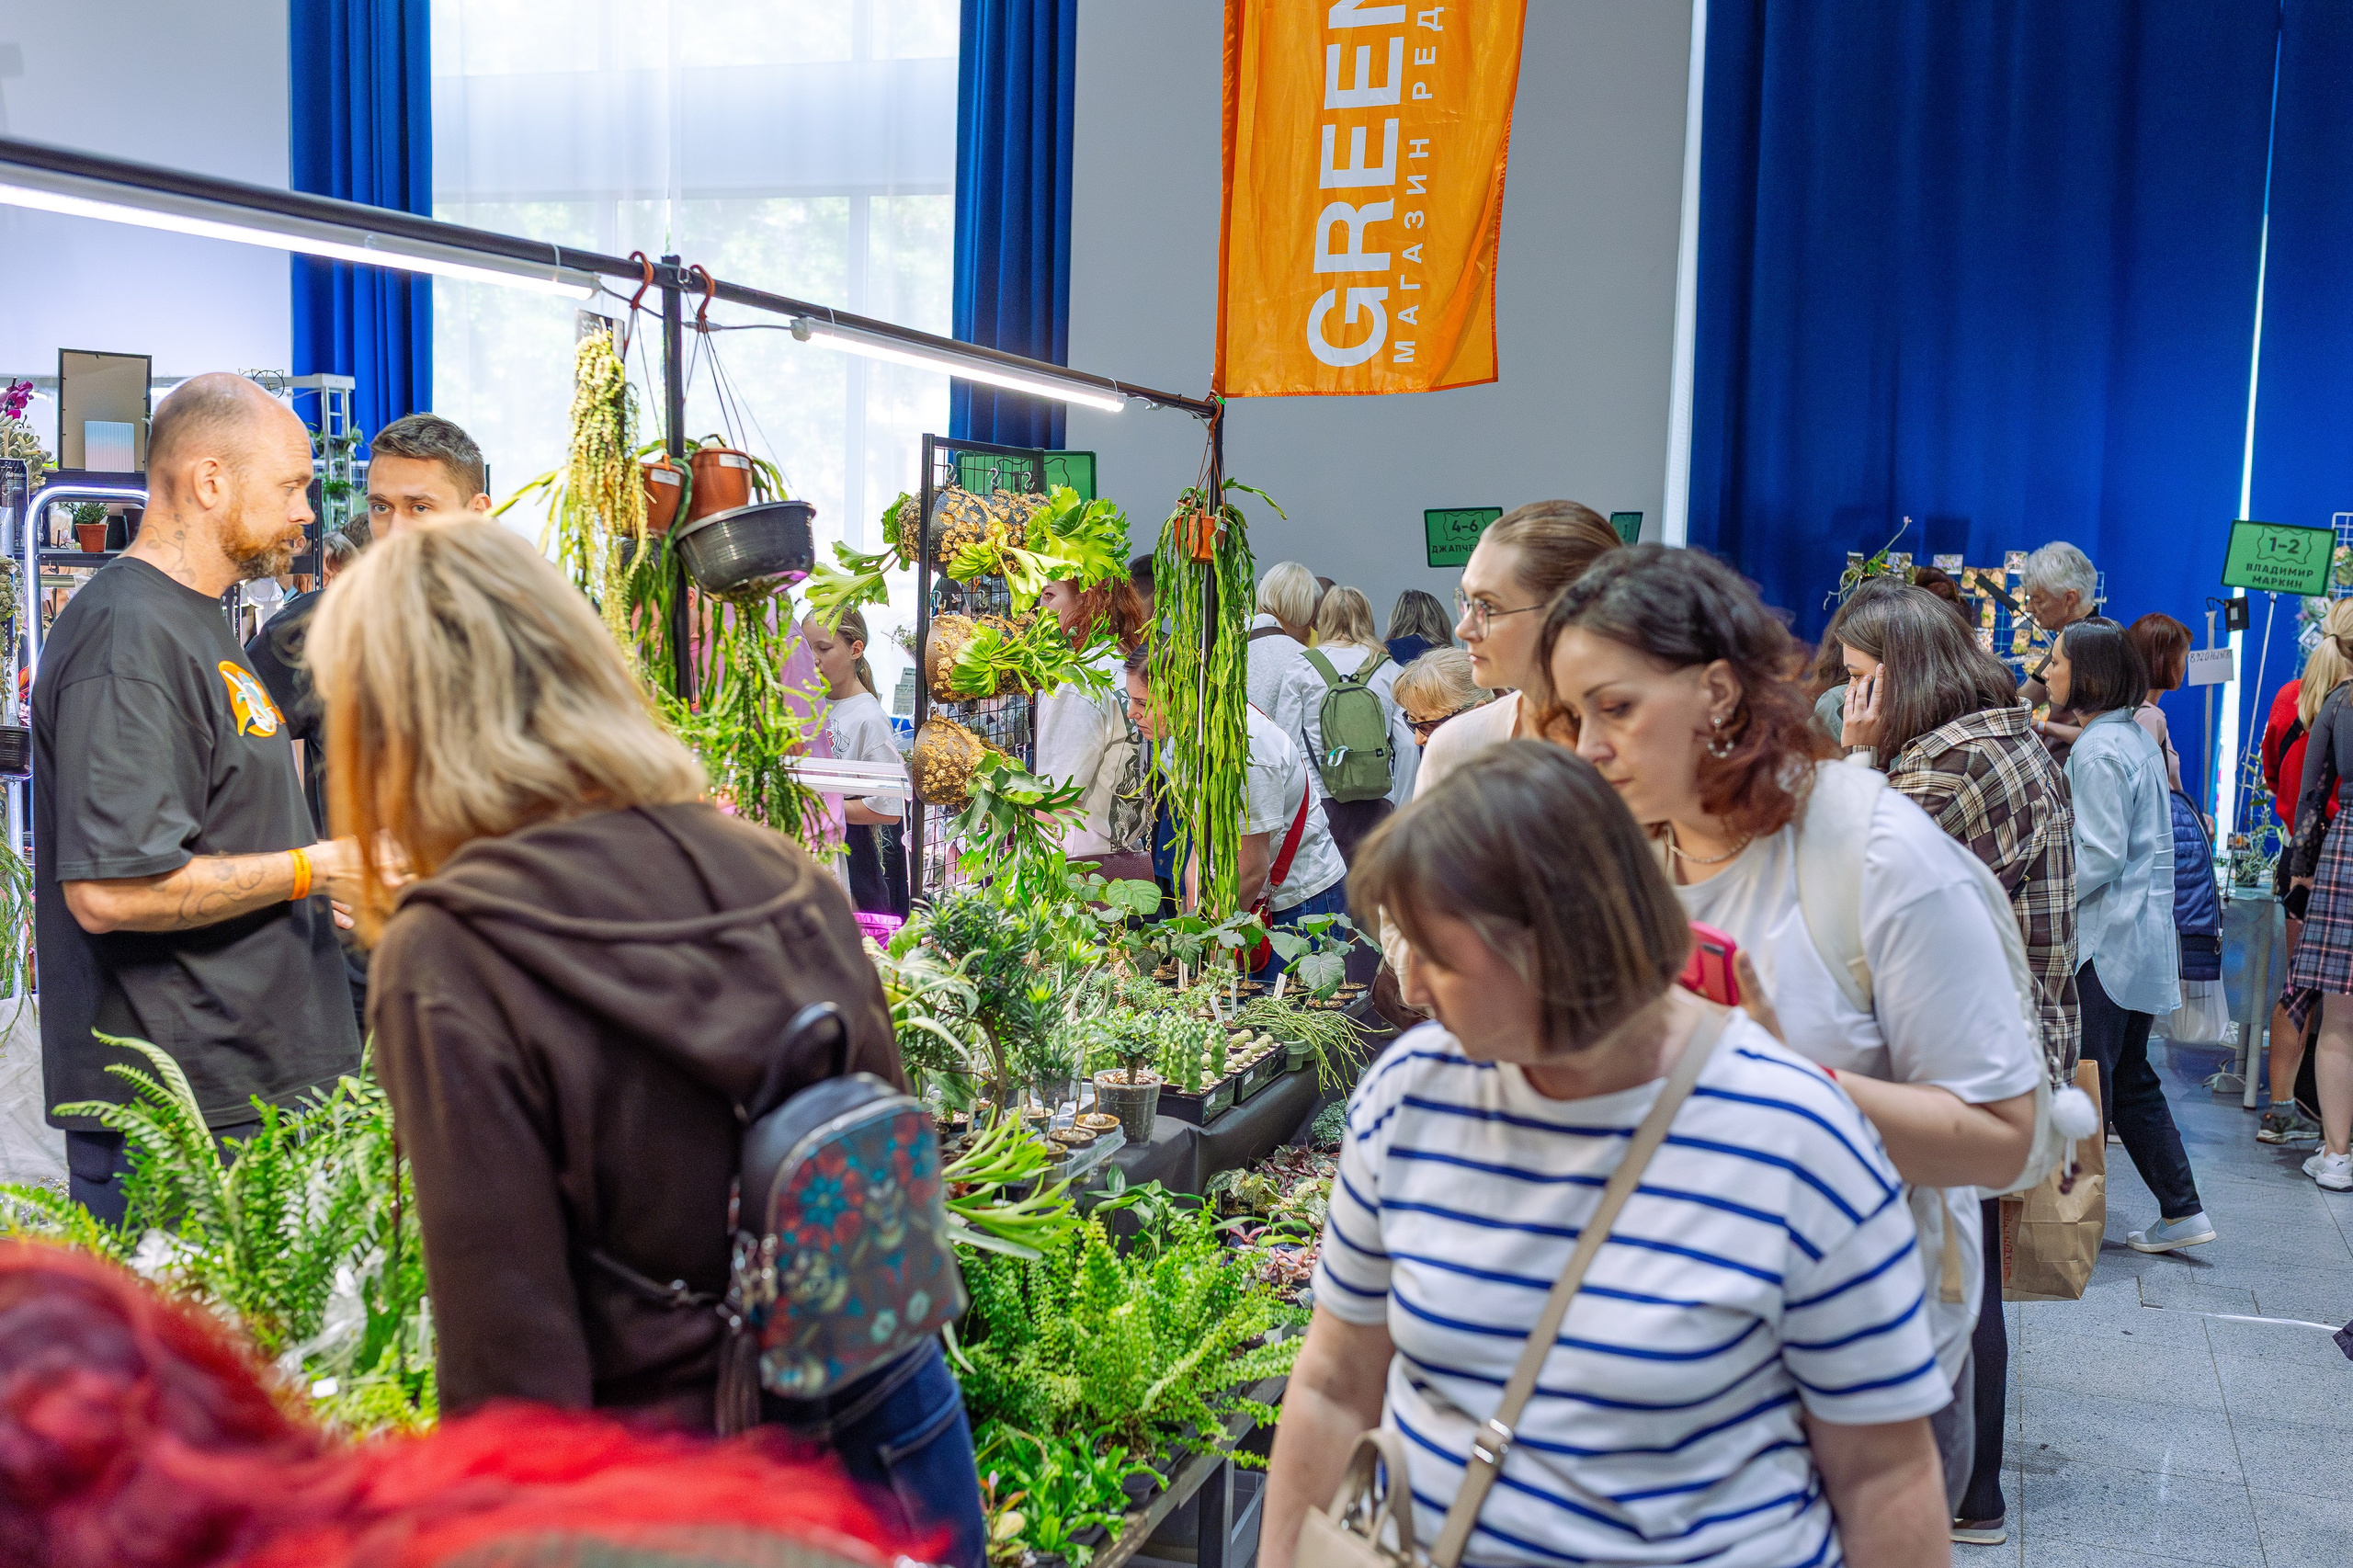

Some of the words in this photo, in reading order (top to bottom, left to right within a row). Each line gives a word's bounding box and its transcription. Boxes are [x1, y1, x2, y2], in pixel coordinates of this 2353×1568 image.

[1392, 138, 1430, 363] МАГАЗИН
[1452, 519, 1479, 533] 4-6
[1432, 544, 1477, 553] ДЖАПЧЕ
[2268, 536, 2301, 554] 1-2
[2245, 562, 2314, 578] ВЛАДИМИР
[2252, 575, 2303, 588] МАРКИН
